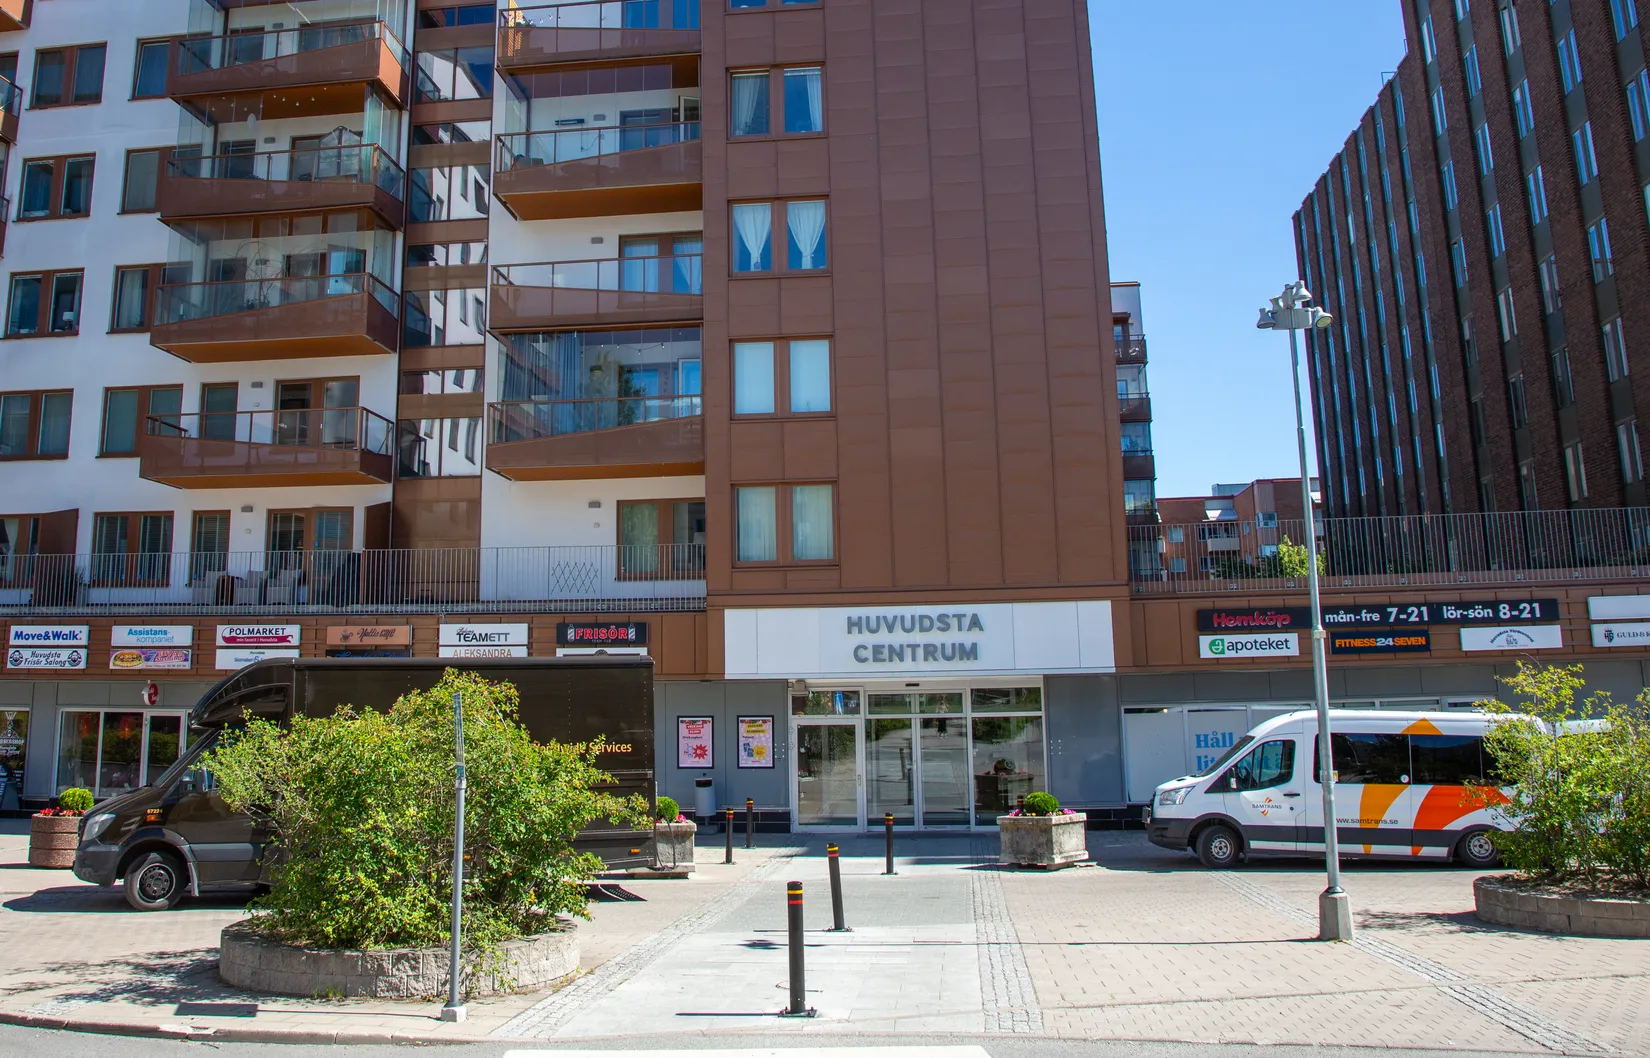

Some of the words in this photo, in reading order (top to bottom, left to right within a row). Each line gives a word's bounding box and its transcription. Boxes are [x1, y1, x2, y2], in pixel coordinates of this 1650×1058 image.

[1212, 611, 1291, 628] Hemköp
[1325, 609, 1380, 623] mån-fre
[1386, 606, 1429, 623] 7-21
[1442, 605, 1494, 619] lör-sön
[1498, 602, 1542, 619] 8-21
[846, 612, 985, 635] HUVUDSTA
[127, 628, 171, 636] Assistans-
[229, 627, 287, 636] POLMARKET
[575, 625, 628, 639] FRISÖR
[136, 636, 175, 644] kompaniet
[1226, 638, 1291, 654] apoteket
[30, 650, 61, 659] Huvudsta
[453, 648, 512, 658] ALEKSANDRA
[853, 642, 979, 664] CENTRUM
[23, 657, 43, 666] Frisör
[44, 657, 67, 667] Salong
[1194, 730, 1234, 748] Håll
[589, 741, 632, 753] Services
